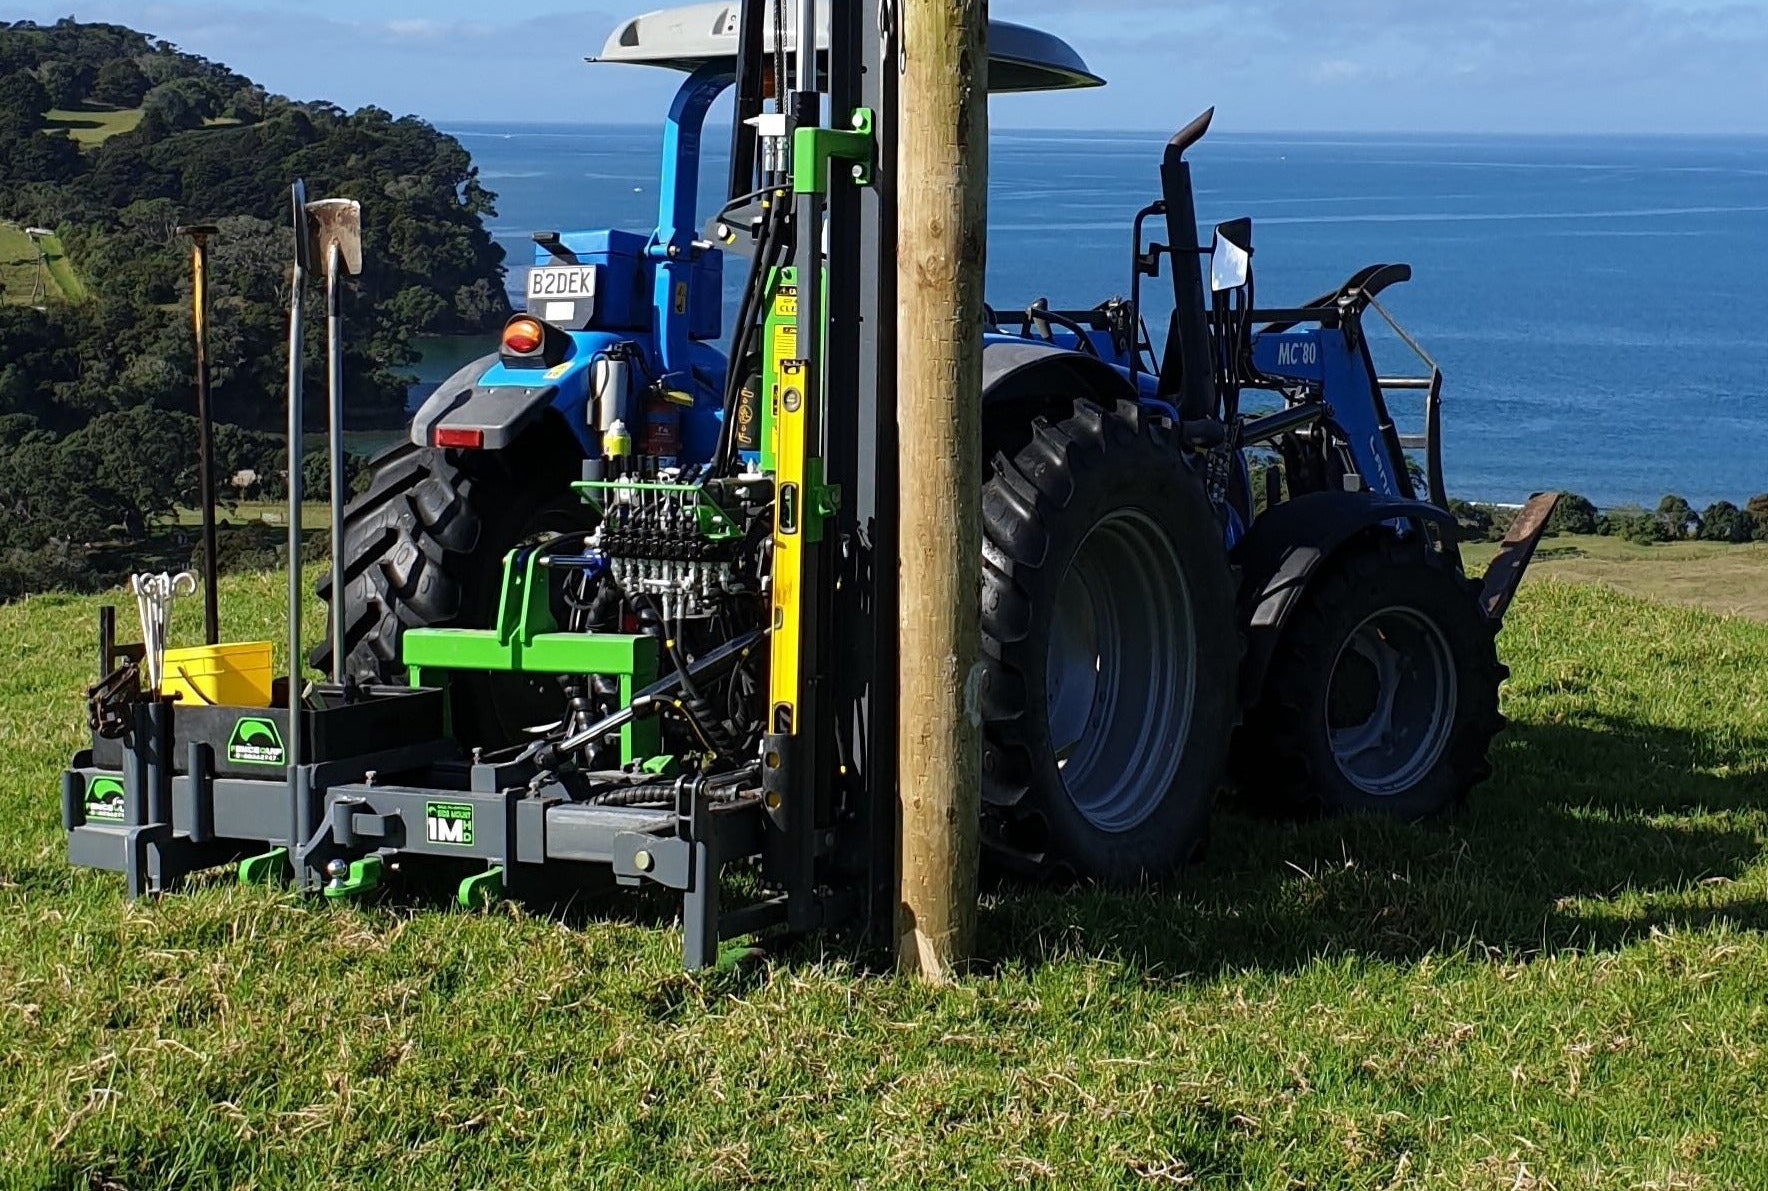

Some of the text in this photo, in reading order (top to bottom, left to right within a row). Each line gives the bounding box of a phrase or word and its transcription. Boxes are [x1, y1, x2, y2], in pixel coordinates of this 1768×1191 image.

[532, 272, 591, 294] B2DEK
[1277, 342, 1316, 366] MC'80
[428, 817, 463, 842] 1M
